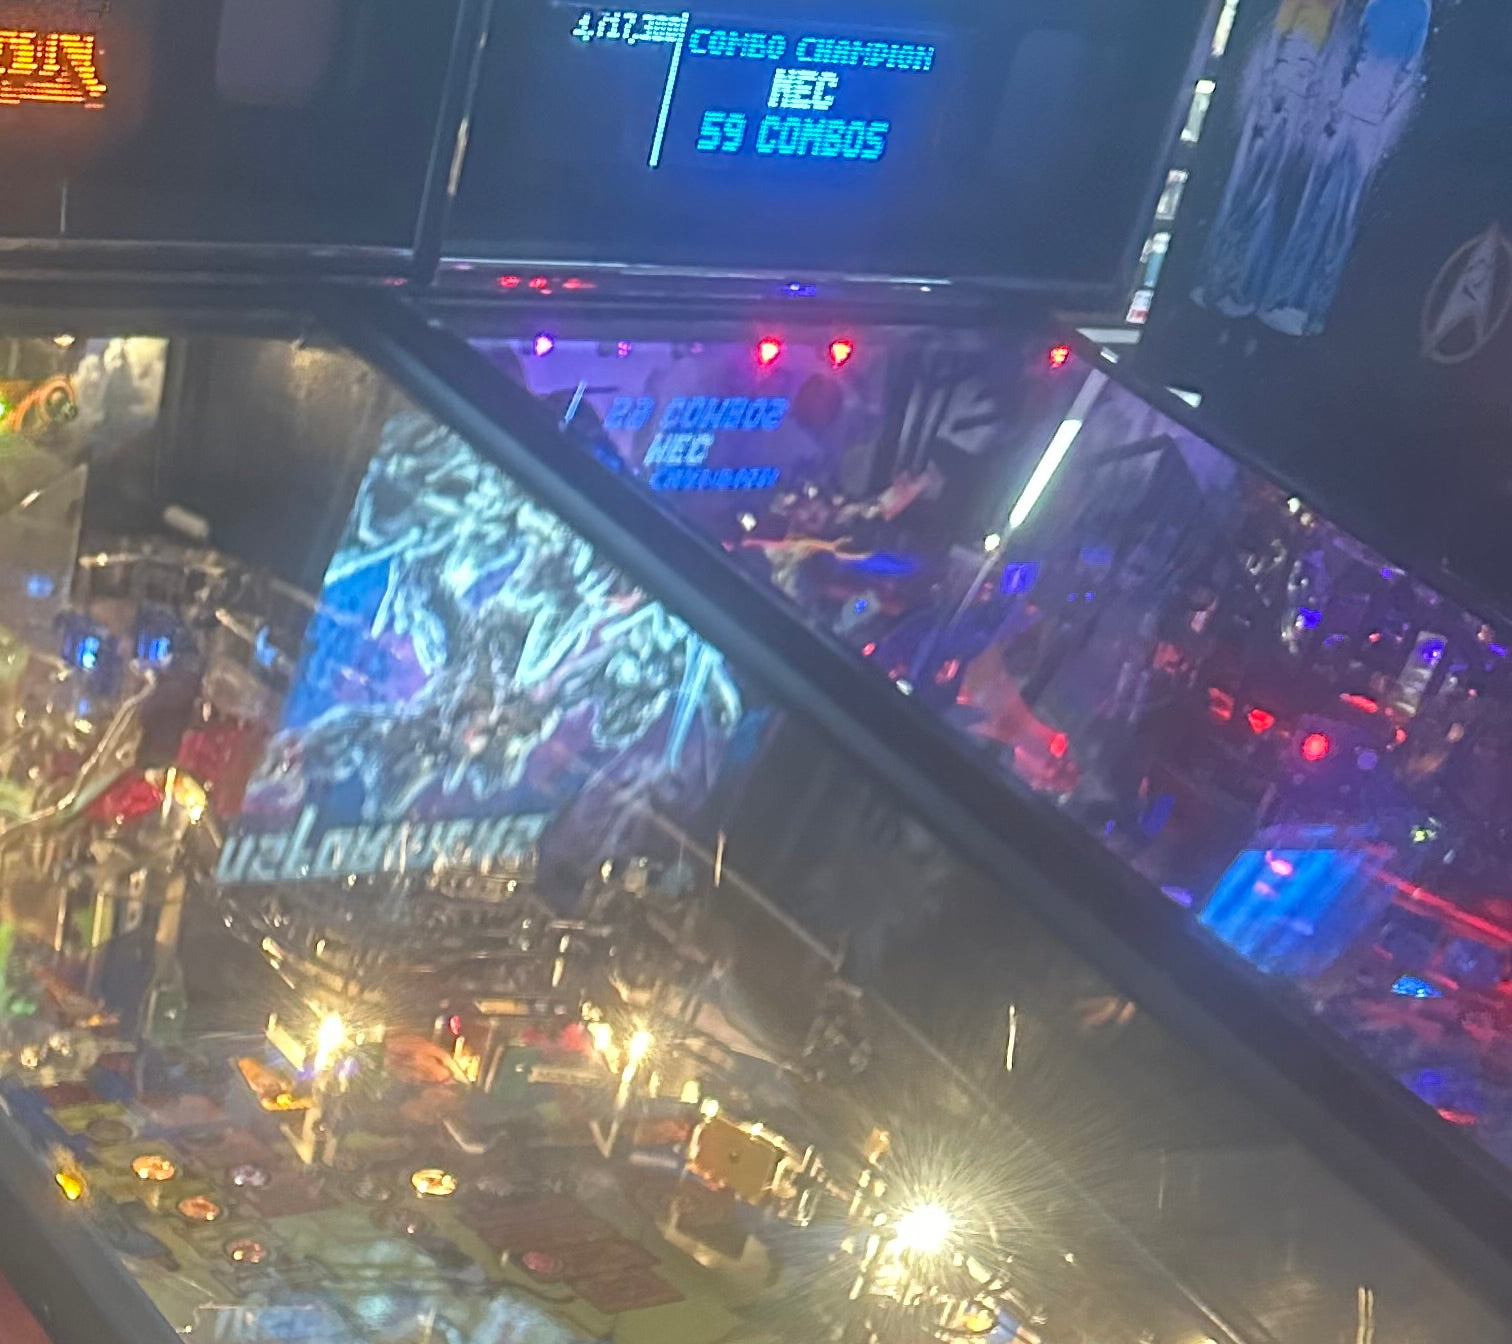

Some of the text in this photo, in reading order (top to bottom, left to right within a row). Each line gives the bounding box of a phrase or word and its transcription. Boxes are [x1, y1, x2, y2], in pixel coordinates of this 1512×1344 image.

[689, 28, 935, 71] COMBO CHAMPION
[768, 68, 839, 110] NEC
[696, 110, 889, 161] 59 COMBOS
